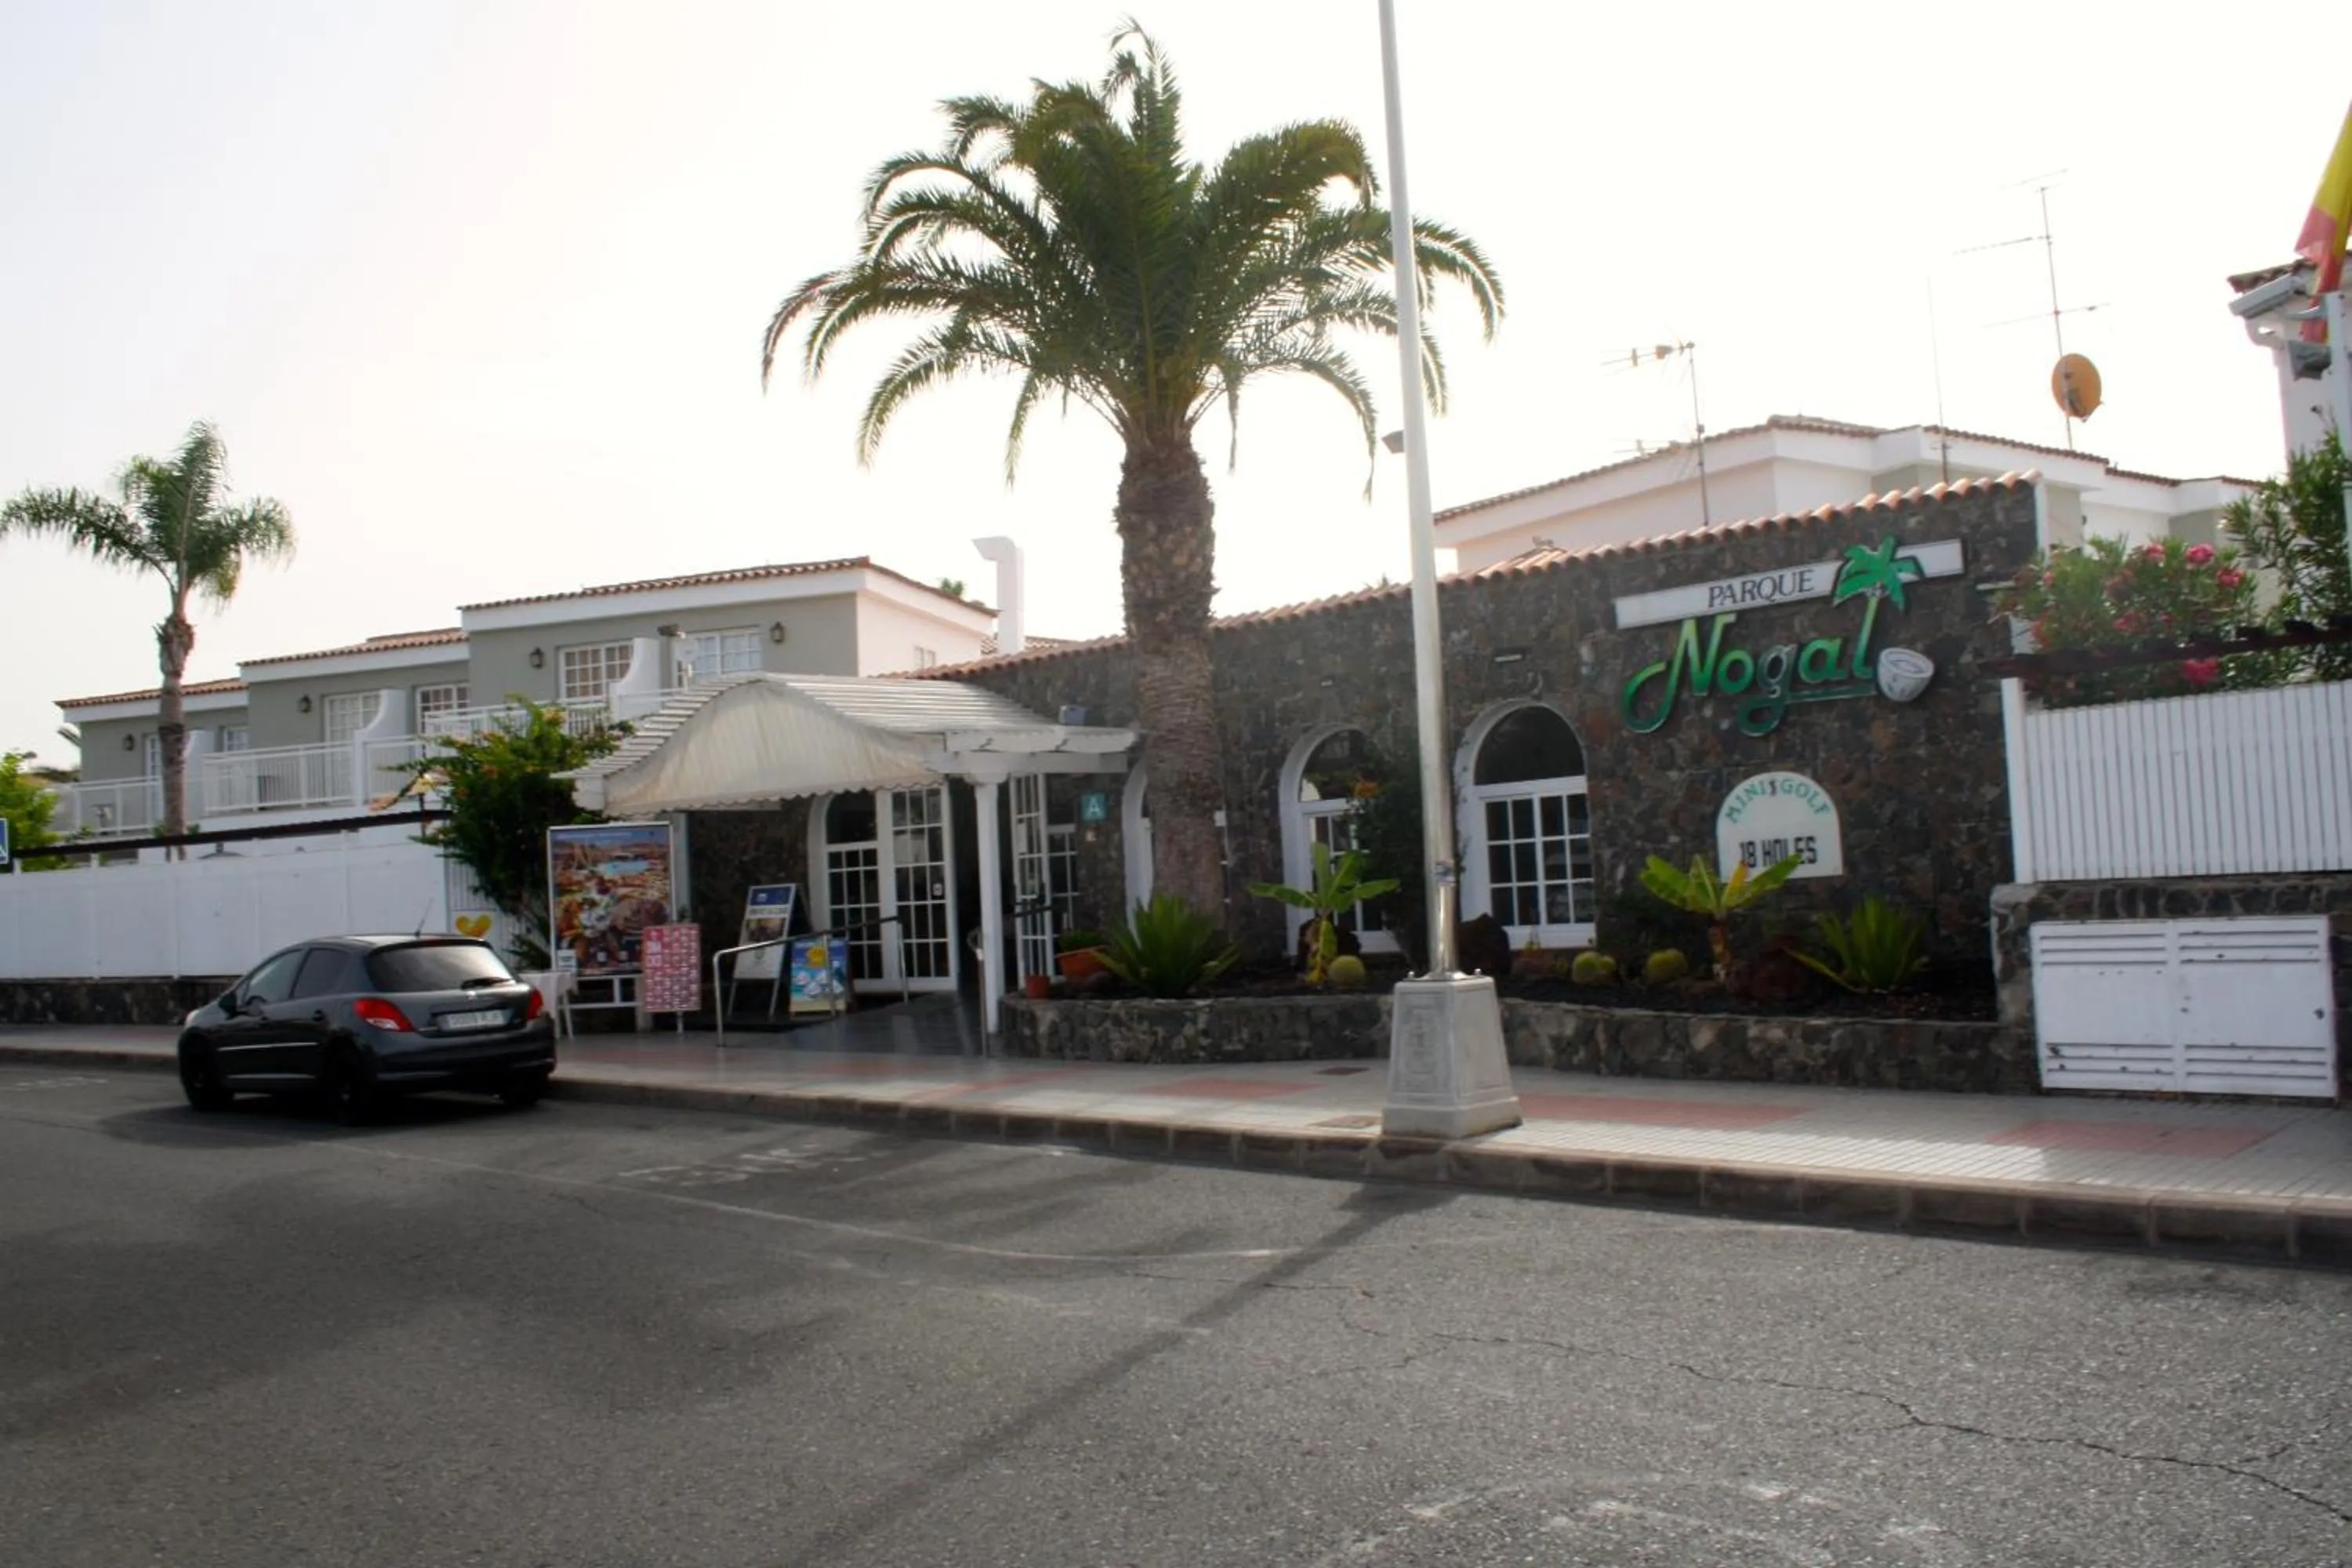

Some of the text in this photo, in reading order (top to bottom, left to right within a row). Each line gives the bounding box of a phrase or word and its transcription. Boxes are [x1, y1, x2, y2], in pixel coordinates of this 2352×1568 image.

[1708, 569, 1815, 608] PARQUE
[1622, 597, 1875, 735] Nogal
[1086, 796, 1104, 818] A
[1725, 779, 1831, 824] MINI GOLF
[1739, 840, 1757, 868] 18
